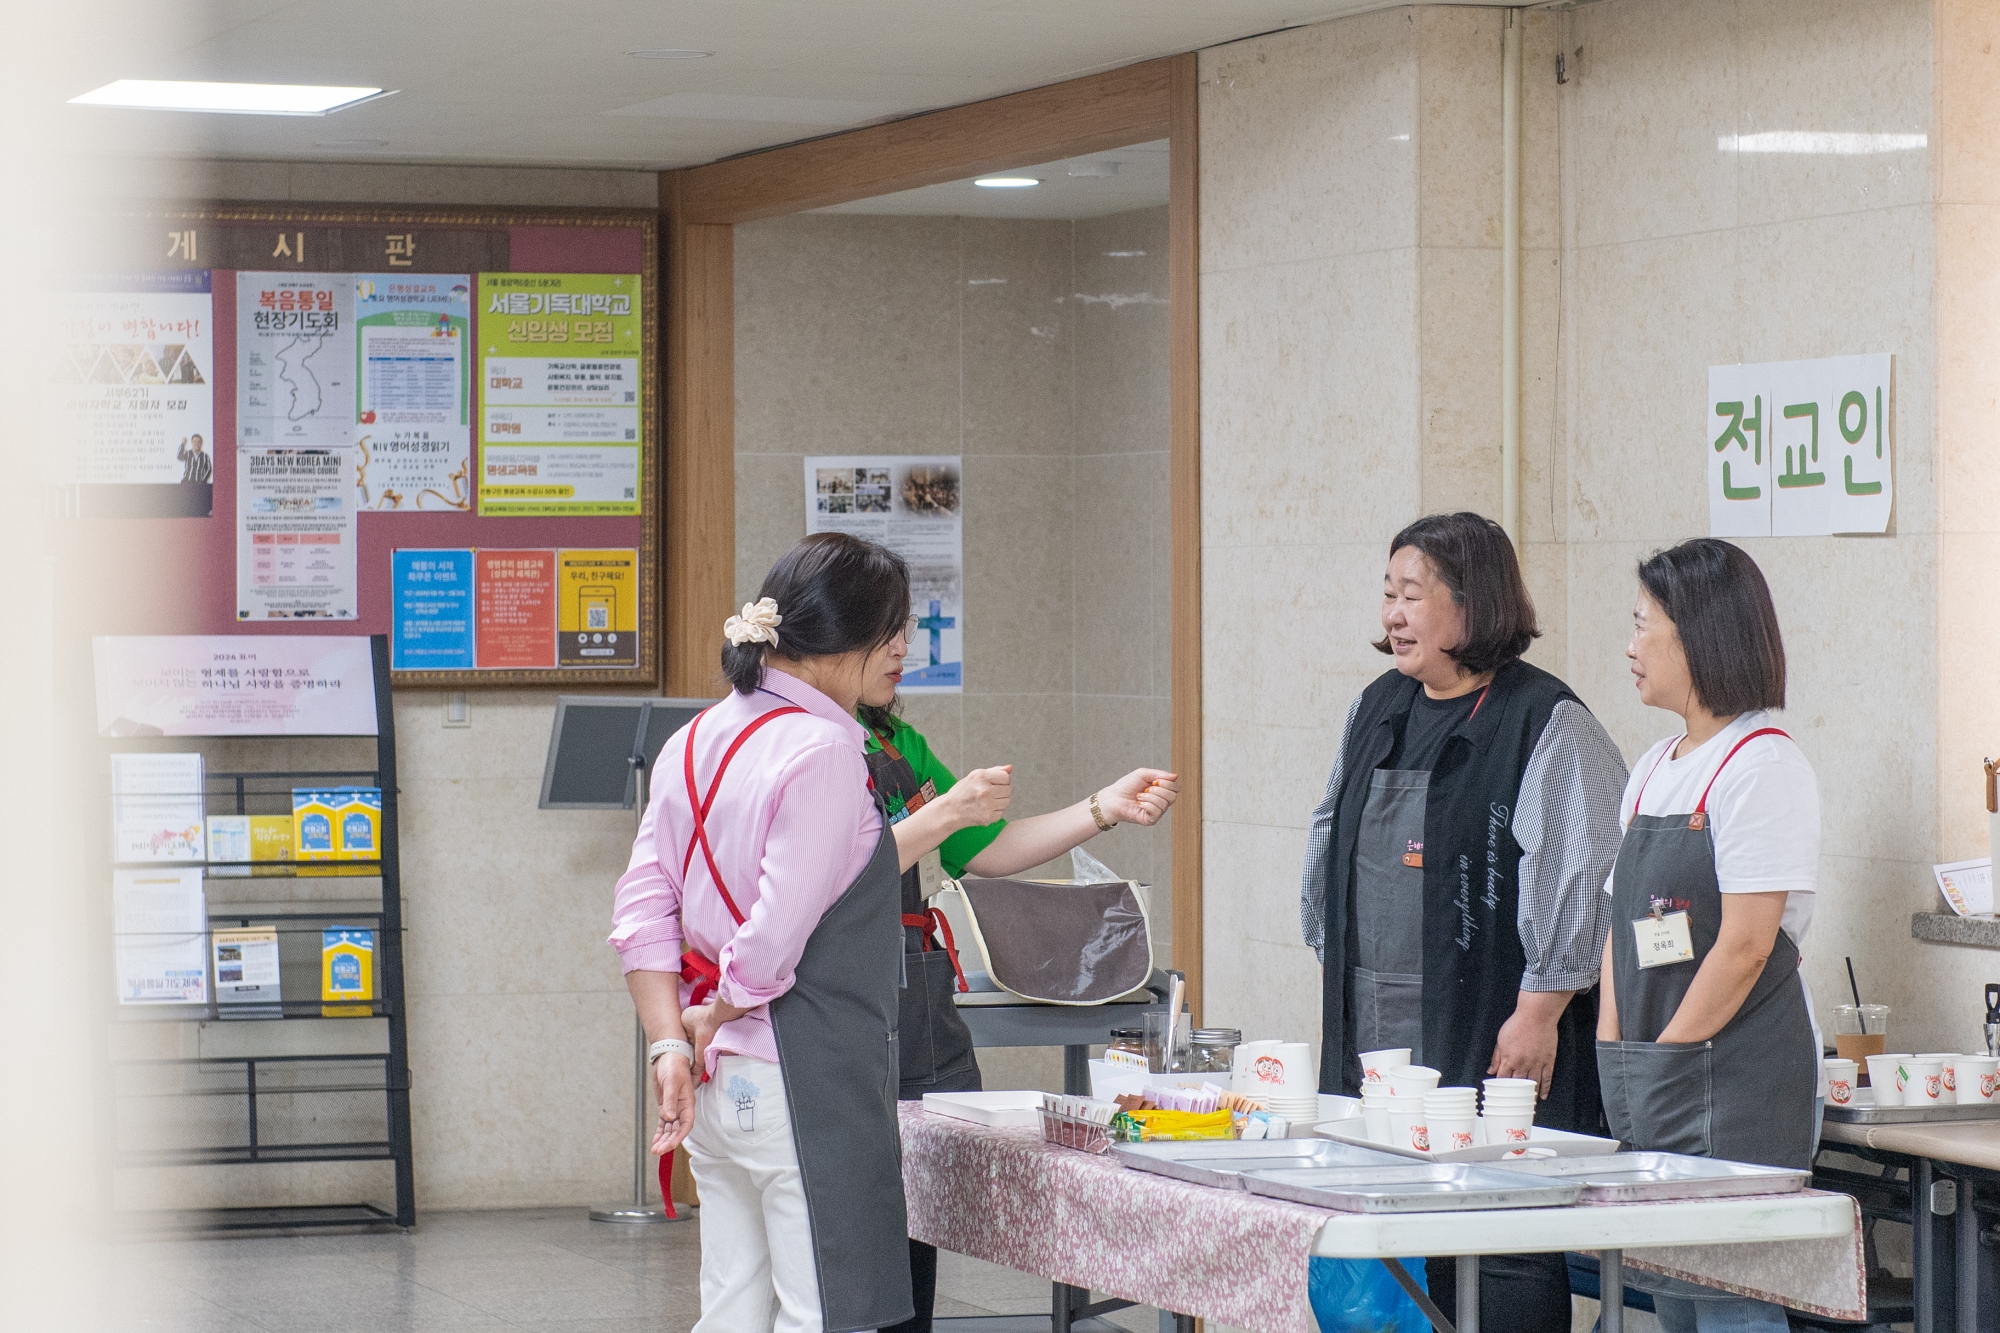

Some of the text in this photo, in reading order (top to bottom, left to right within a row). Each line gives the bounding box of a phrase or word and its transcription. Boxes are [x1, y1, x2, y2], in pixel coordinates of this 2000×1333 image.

[259, 290, 334, 312] 복음통일
[488, 292, 632, 316] 서울기독대학교
[122, 316, 200, 340] 변합니다!
[253, 310, 339, 331] 현장기도회
[507, 319, 615, 343] 신입생 모집
[490, 377, 523, 390] 대학교
[1714, 385, 1883, 501] 전교인
[250, 455, 342, 467] 3DAYS NEW KOREA MINI
[570, 570, 625, 582] 우리, 친구해요!
[1487, 801, 1509, 848] There
[1486, 850, 1499, 867] is
[1453, 854, 1480, 952] in everything
